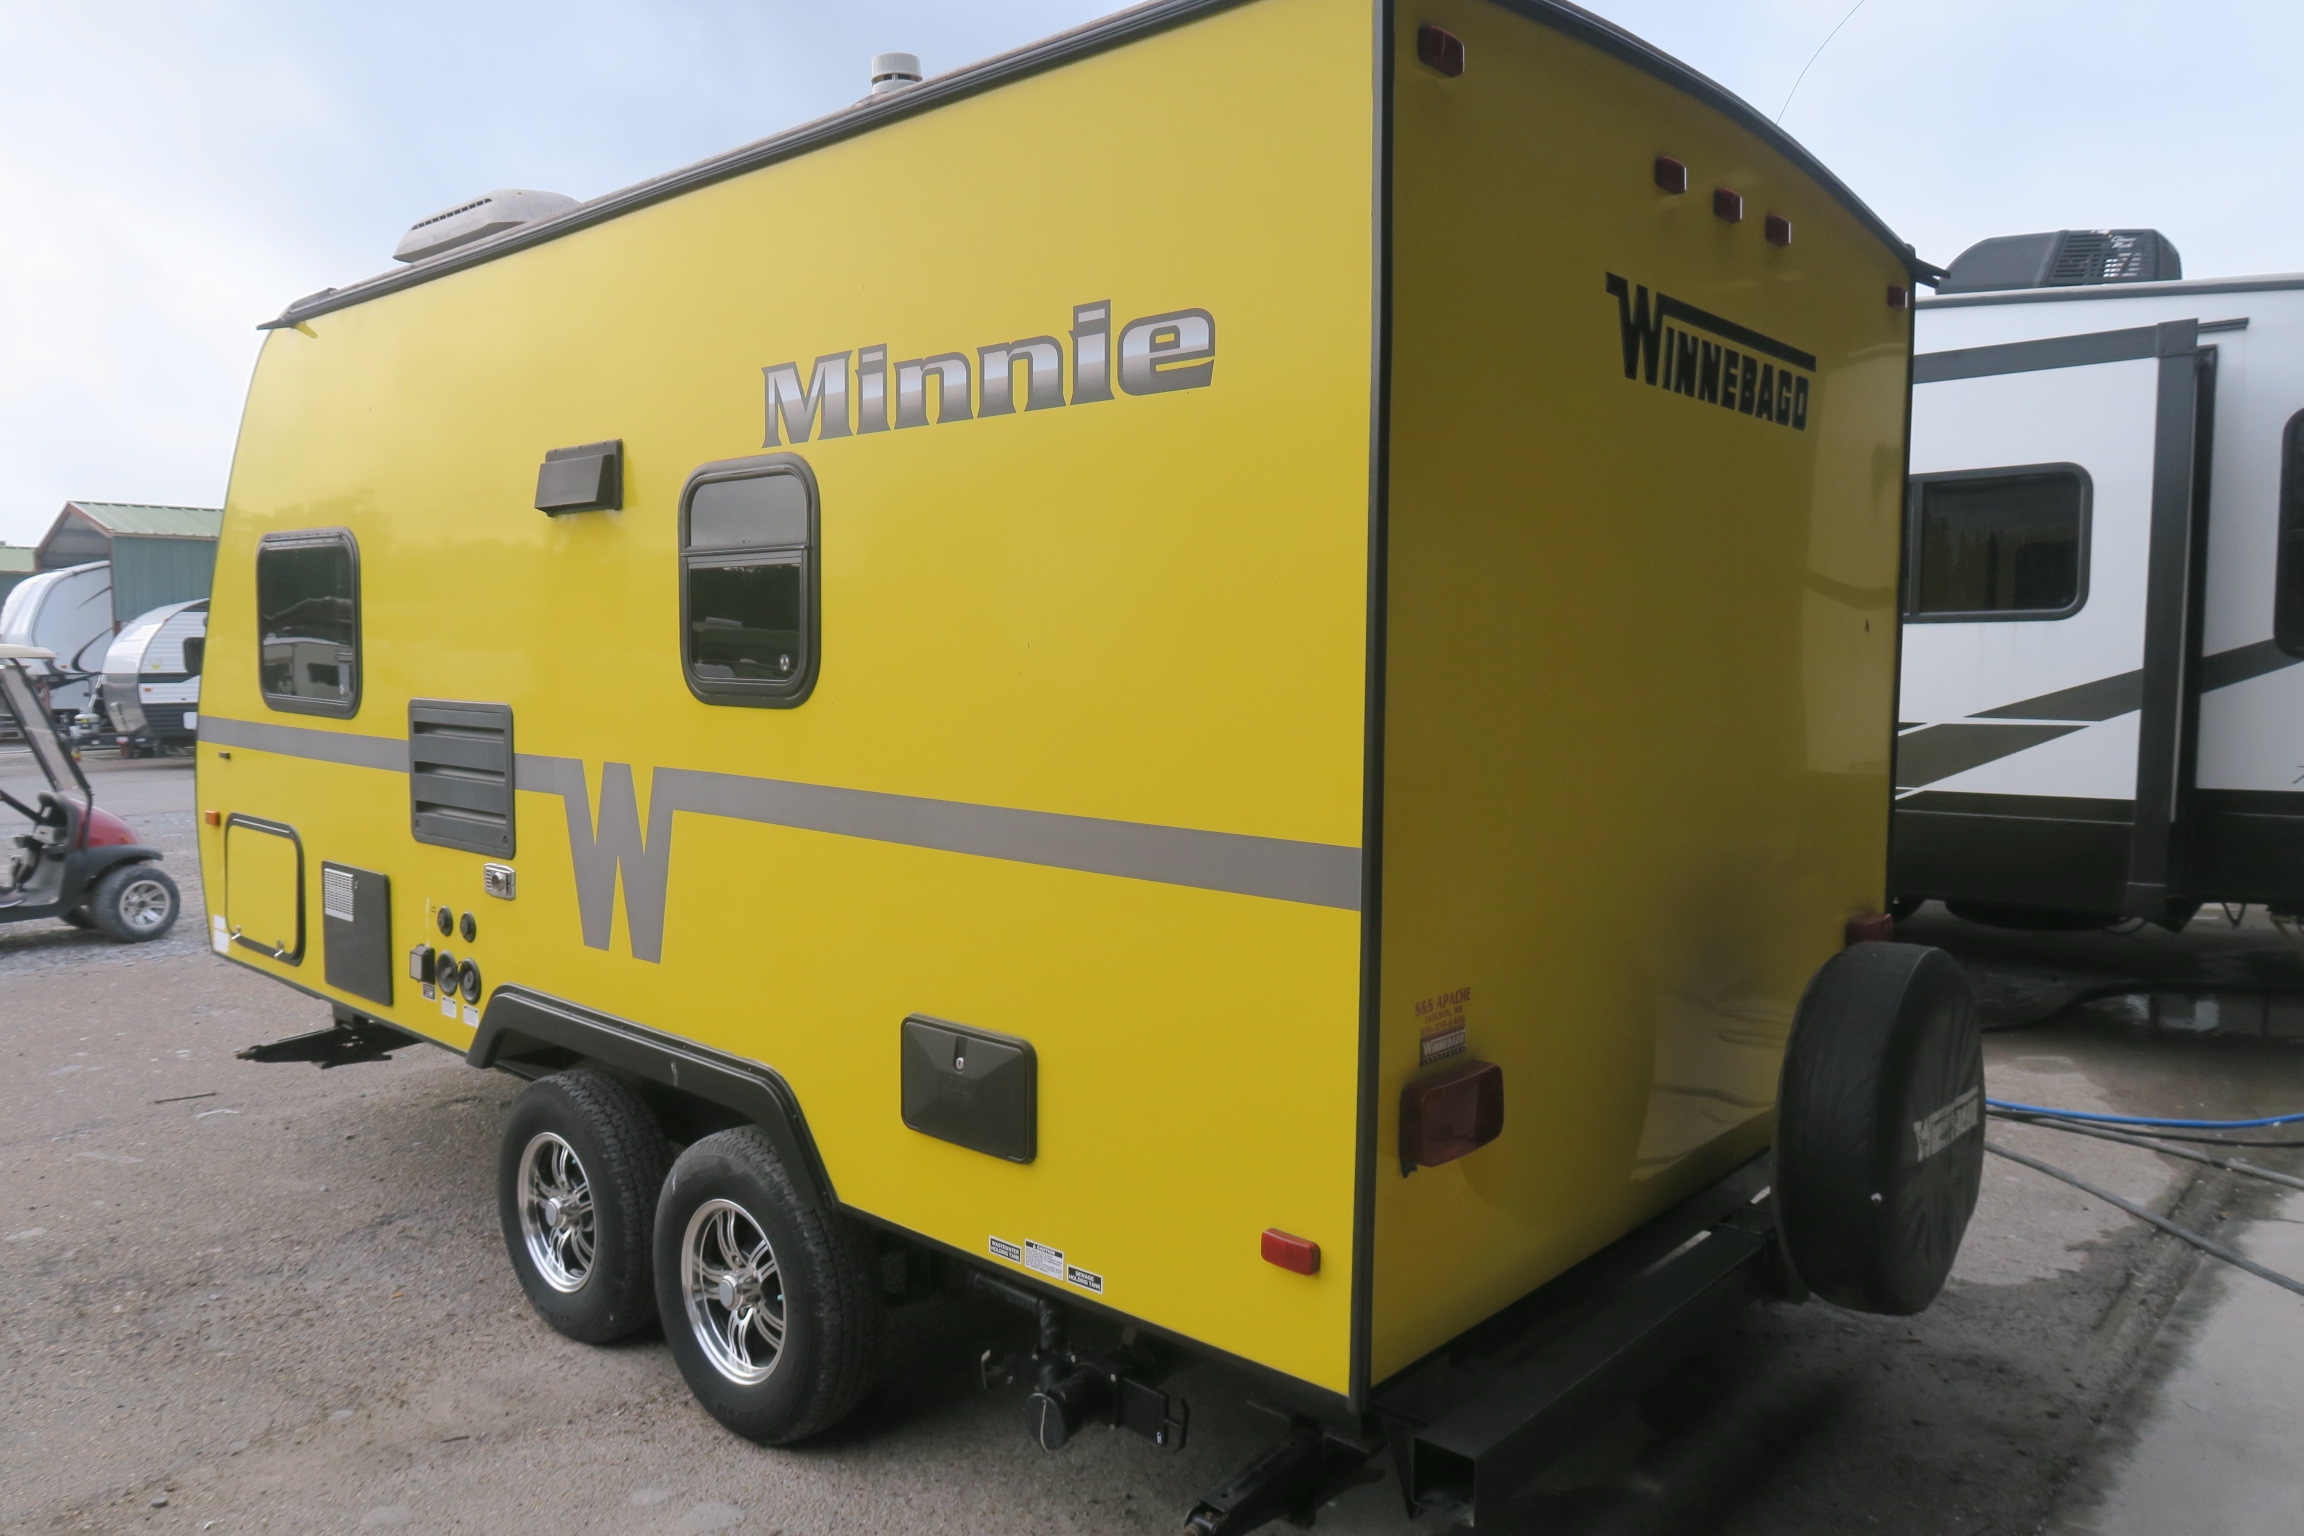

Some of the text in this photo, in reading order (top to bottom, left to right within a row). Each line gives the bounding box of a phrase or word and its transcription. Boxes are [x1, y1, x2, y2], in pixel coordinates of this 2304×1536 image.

[761, 299, 1216, 448] Minnie
[1605, 271, 1817, 431] WINNEBAGO
[562, 757, 674, 965] W
[1437, 986, 1471, 1009] APACHE
[1068, 1273, 1101, 1290] HOLDING TANK
